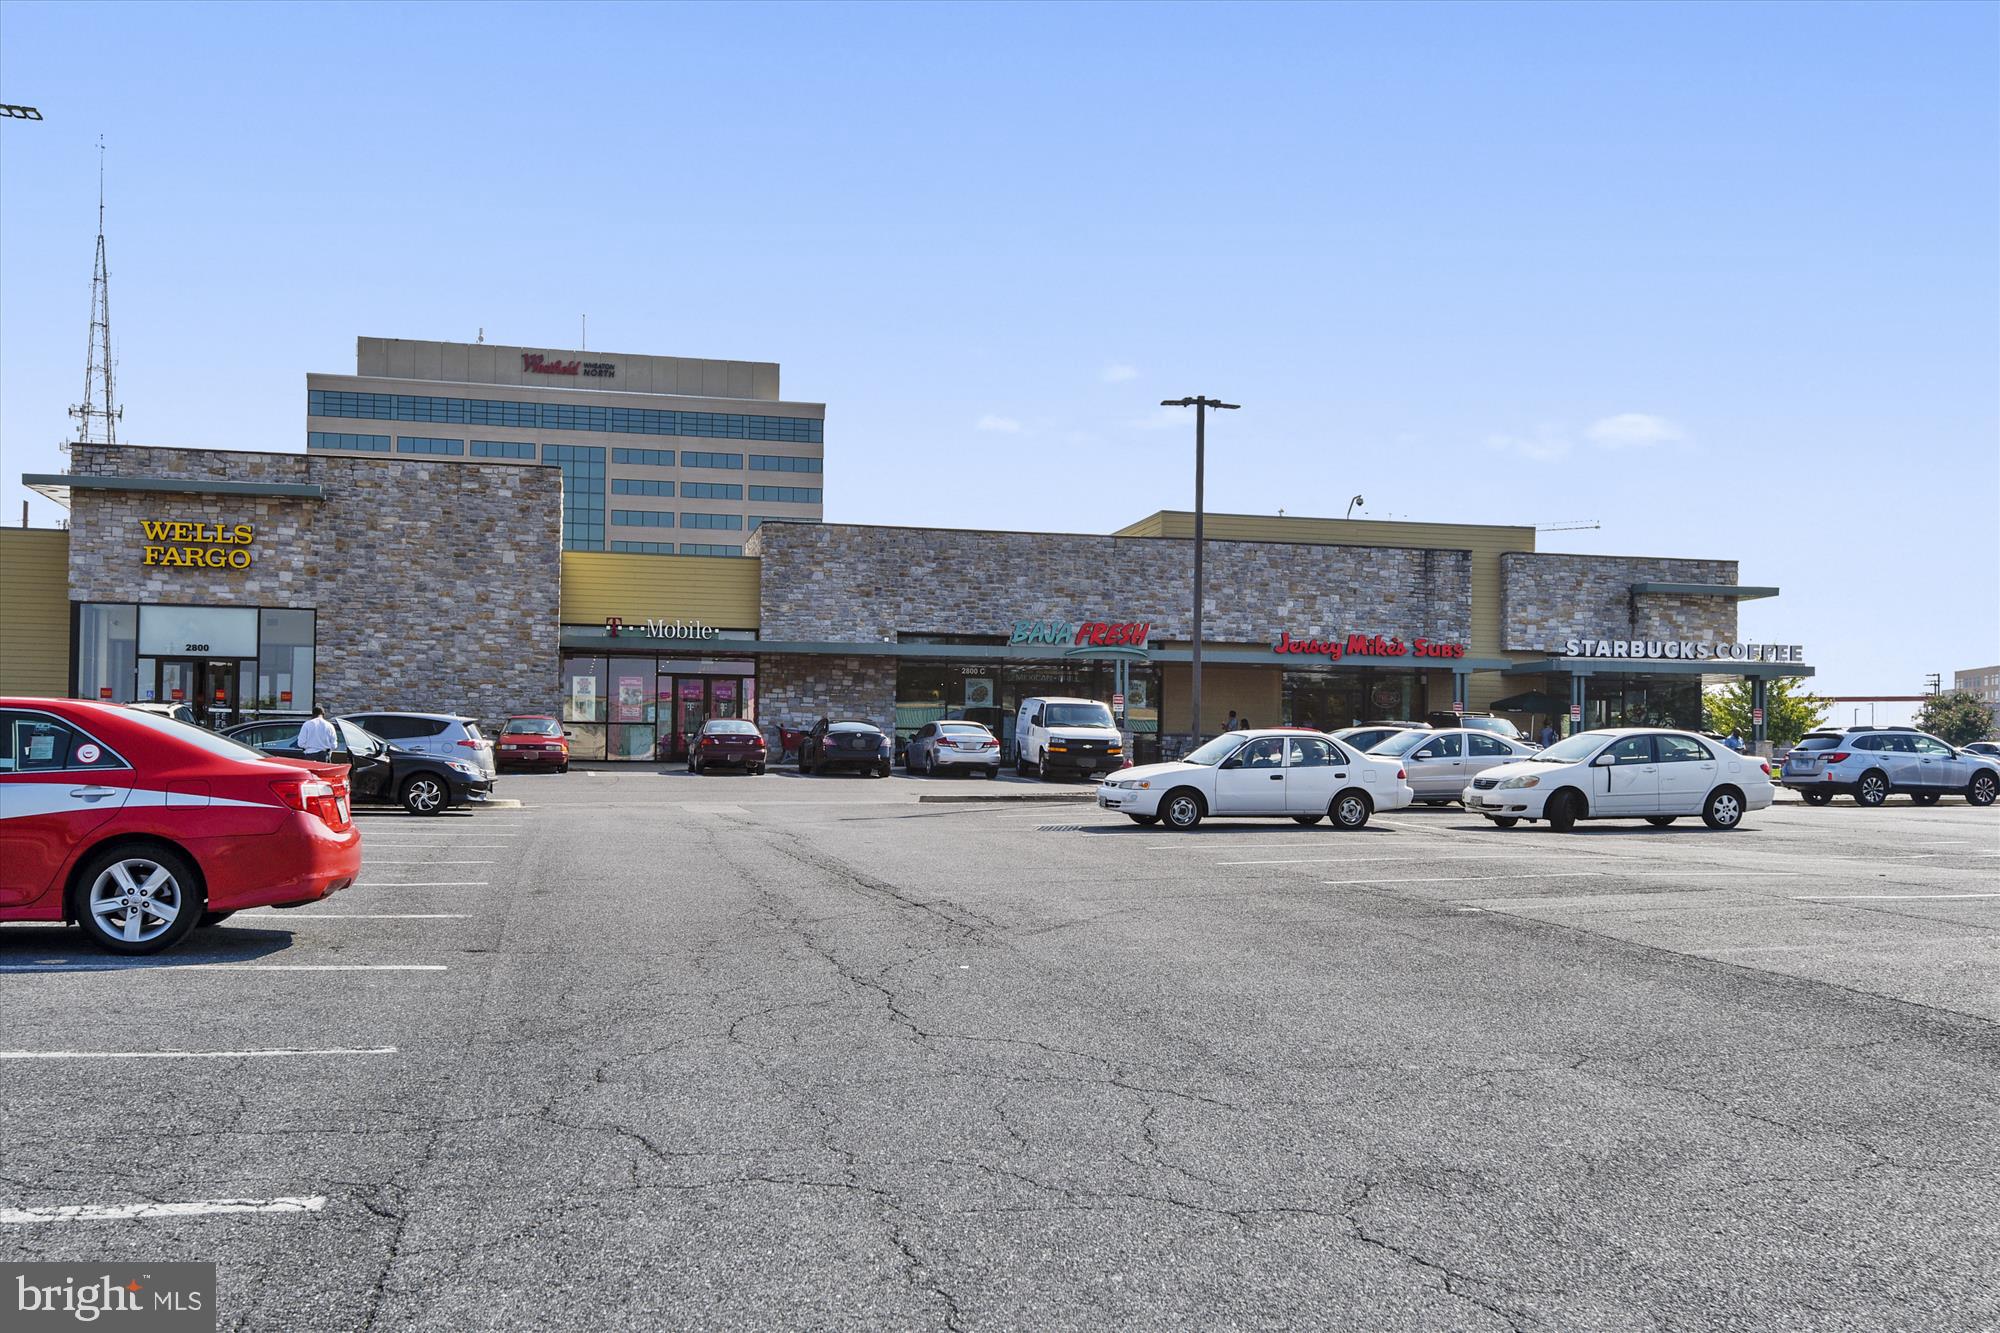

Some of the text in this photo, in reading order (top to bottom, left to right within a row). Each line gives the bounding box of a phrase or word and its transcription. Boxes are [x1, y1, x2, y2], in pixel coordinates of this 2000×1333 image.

[583, 362, 615, 370] WHEATON
[583, 369, 615, 378] NORTH
[140, 520, 254, 545] WELLS
[143, 546, 252, 569] FARGO
[1011, 620, 1151, 647] BAJA FRESH
[185, 644, 210, 652] 2800
[1274, 632, 1343, 661] Jersey
[1347, 634, 1408, 657] Mike's
[1565, 639, 1803, 661] STARBUCKS COFFEE
[961, 667, 978, 675] 2800
